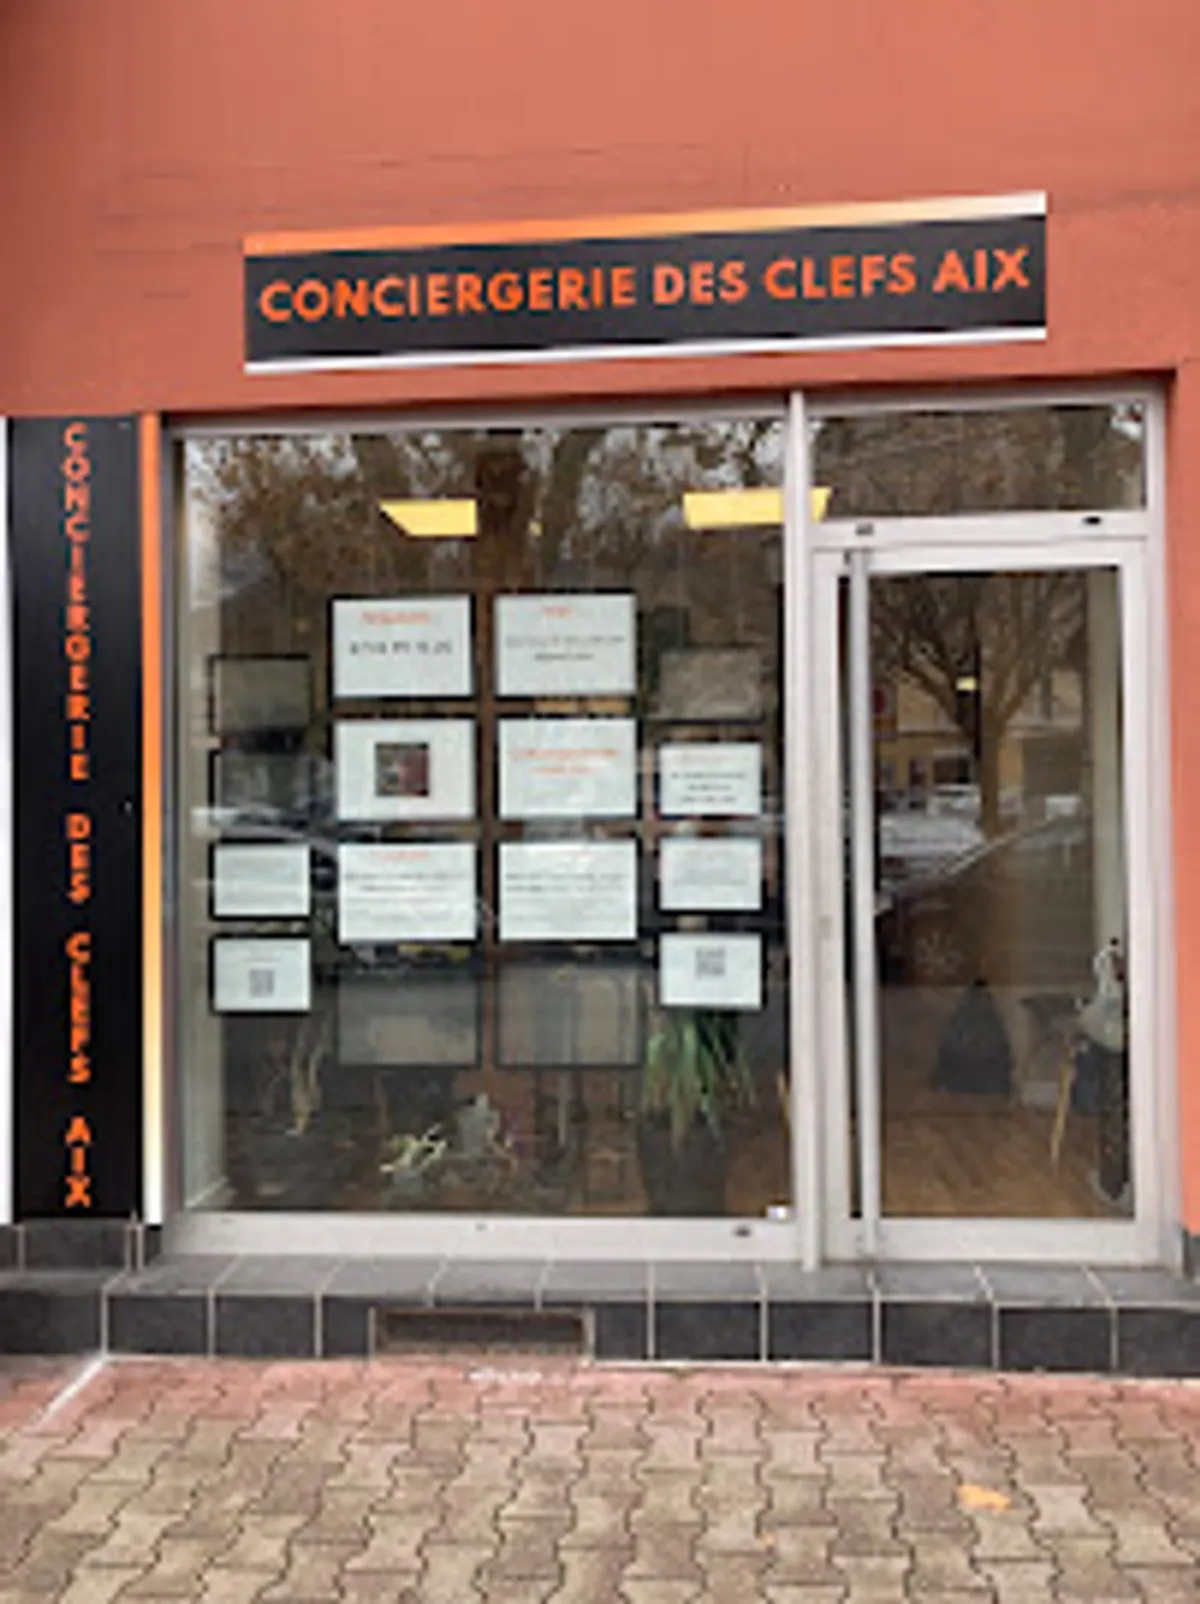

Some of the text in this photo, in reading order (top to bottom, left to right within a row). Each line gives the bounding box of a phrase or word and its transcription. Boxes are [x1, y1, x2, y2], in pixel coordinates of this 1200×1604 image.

[259, 247, 1030, 323] CONCIERGERIE DES CLEFS AIX
[63, 421, 91, 1207] CONCIERGERIE DES CLEFS AIX
